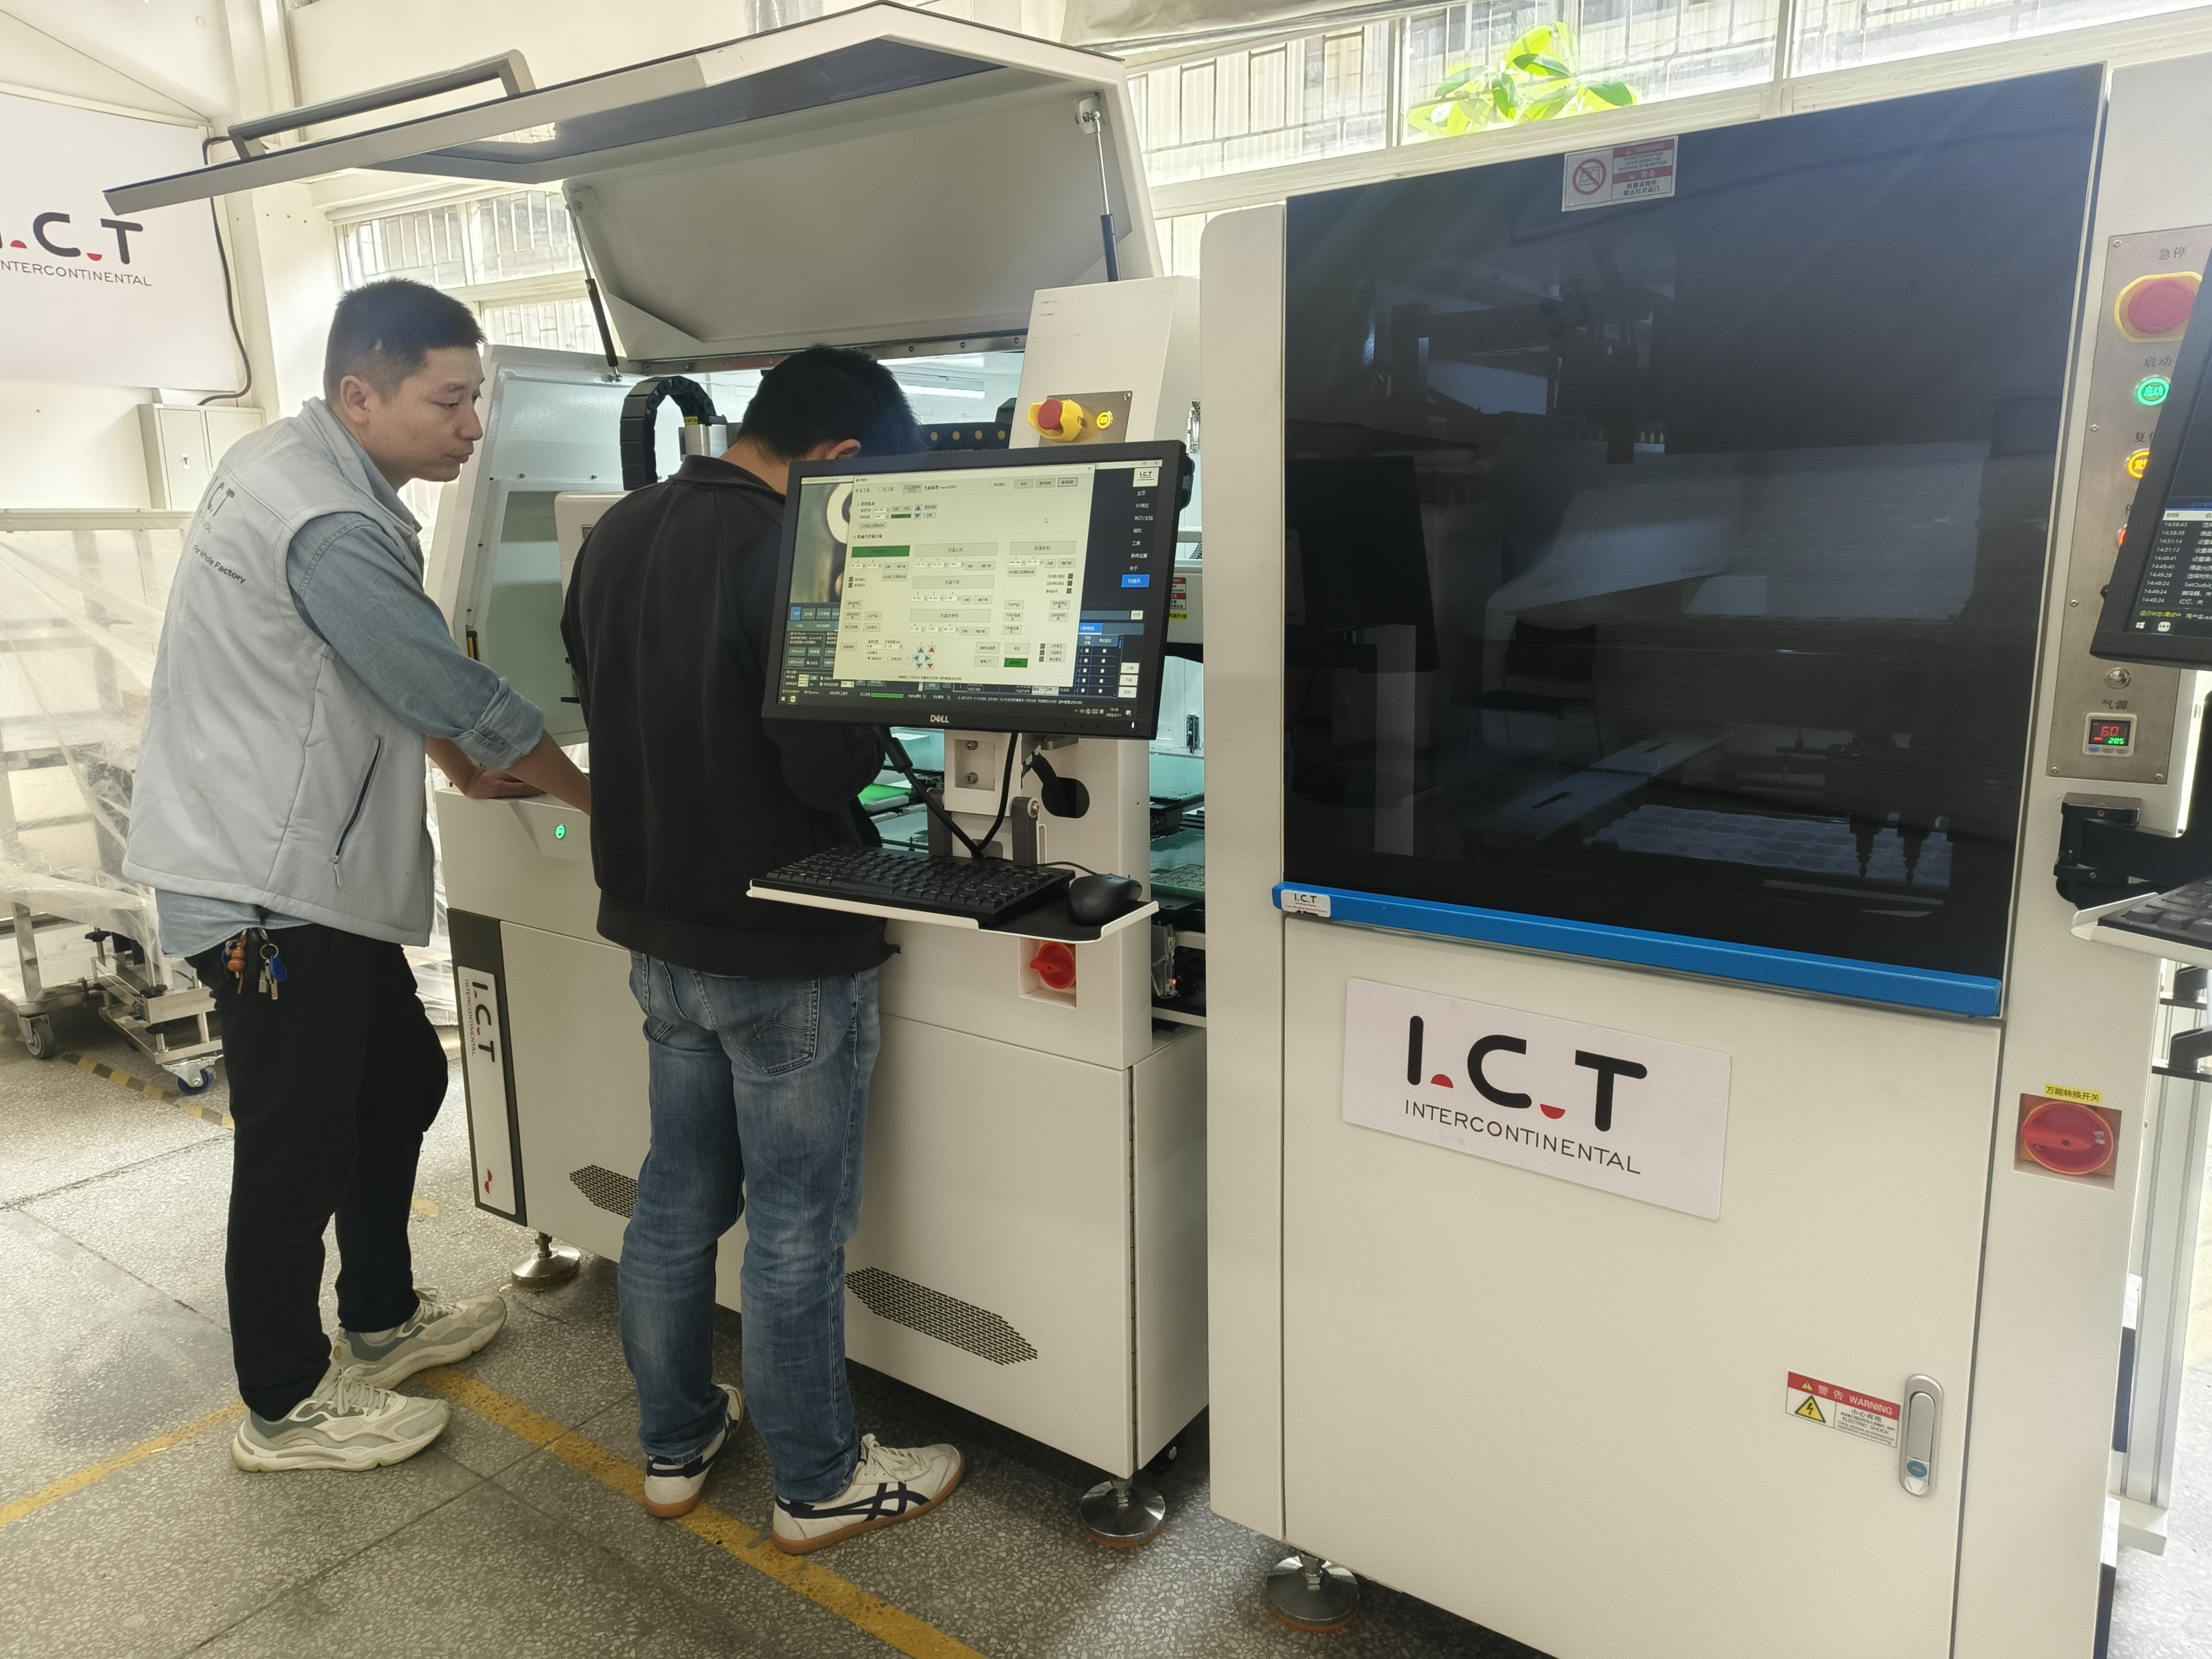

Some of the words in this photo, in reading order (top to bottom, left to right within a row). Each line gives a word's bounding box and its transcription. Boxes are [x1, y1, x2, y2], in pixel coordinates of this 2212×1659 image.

[1635, 143, 1665, 153] WARNING
[0, 212, 143, 265] .C.T
[2157, 246, 2187, 260] 急停
[1, 260, 152, 286] NTERCONTINENTAL
[2143, 355, 2172, 368] 启动
[200, 549, 214, 565] Whole
[214, 561, 246, 584] Factory
[2102, 699, 2128, 710] 气源
[930, 714, 949, 723] DELL
[1294, 893, 1317, 903] I.C.T
[465, 979, 475, 1056] INTERCONTINENTAL
[472, 981, 495, 1063] I.C.T
[1407, 1015, 1647, 1131] I.C.T
[2046, 1086, 2100, 1103] 万能转换开关
[1405, 1100, 1641, 1175] INTERCONTINENTAL
[2096, 1133, 2105, 1141] ON
[1818, 1385, 1844, 1400] 警告
[1849, 1395, 1892, 1415] WARNING
[1851, 1408, 1882, 1423] 小心有电
[1842, 1417, 1868, 1428] ELECTRIC
[1870, 1425, 1890, 1435] SHOCK
